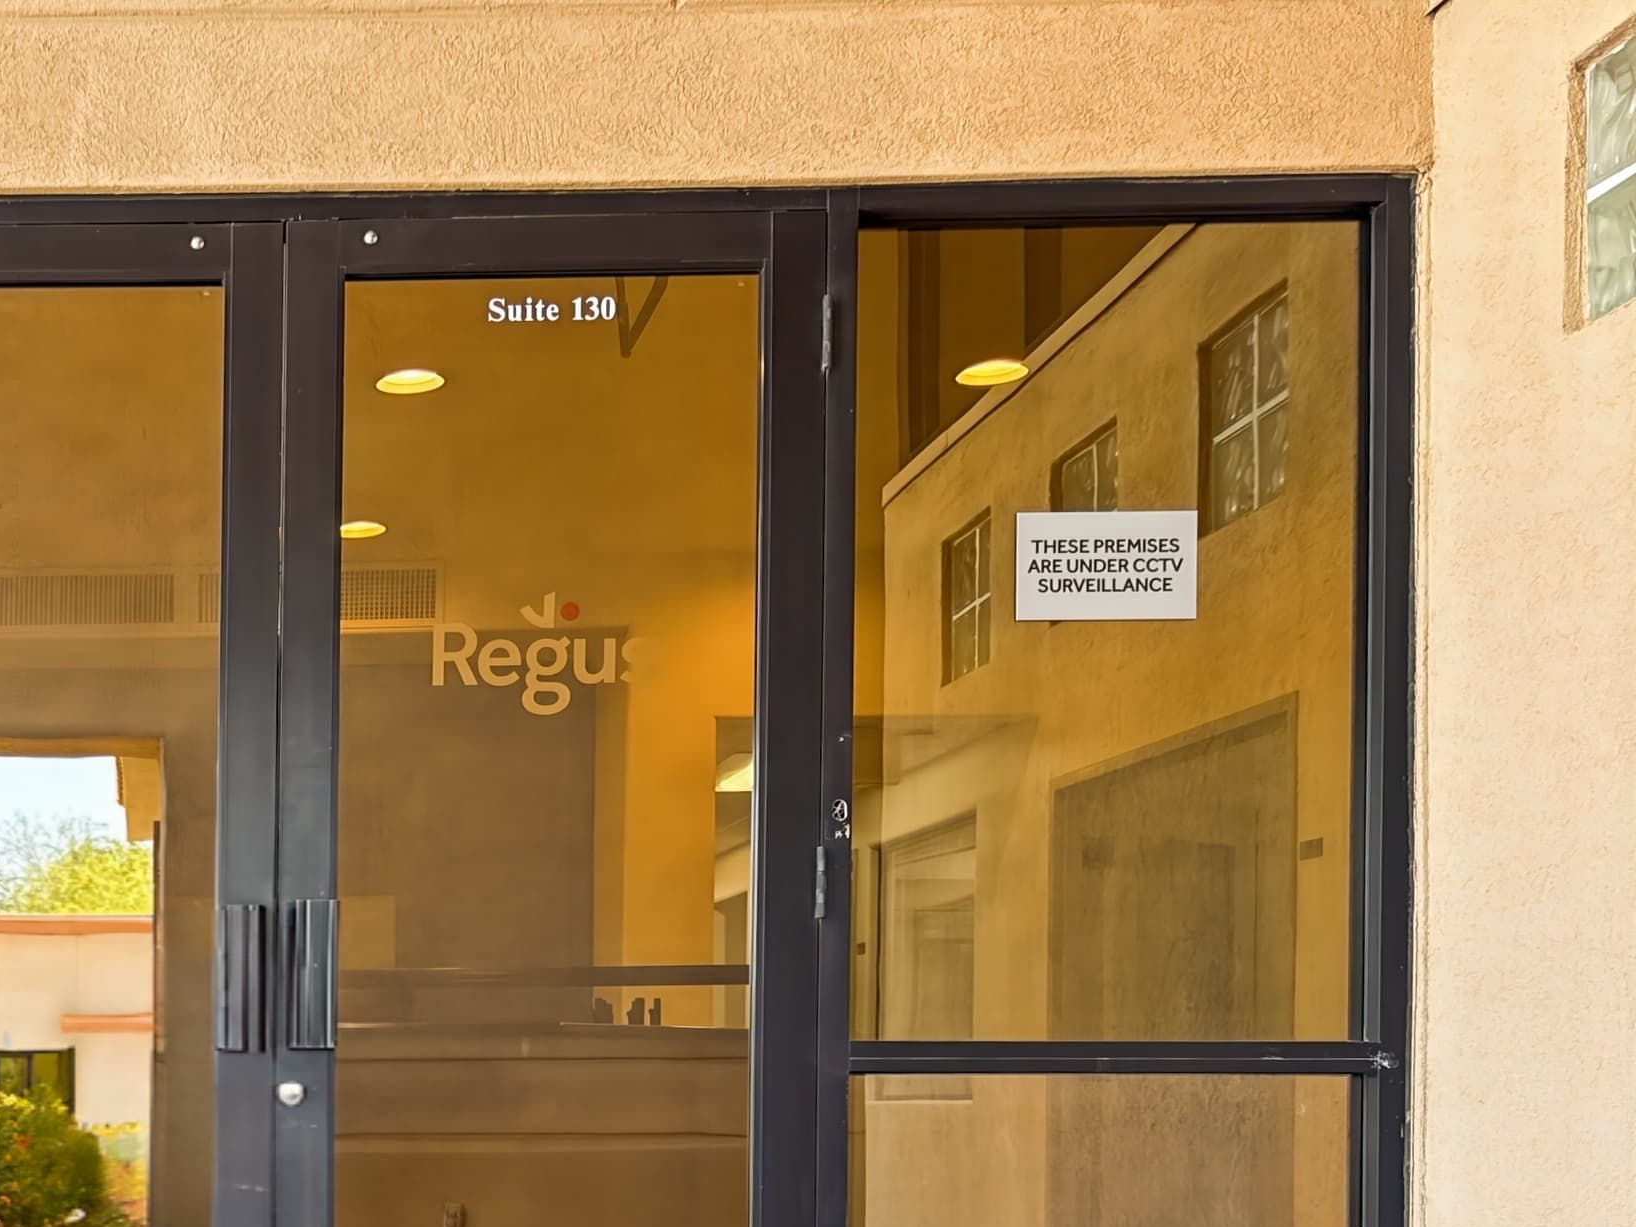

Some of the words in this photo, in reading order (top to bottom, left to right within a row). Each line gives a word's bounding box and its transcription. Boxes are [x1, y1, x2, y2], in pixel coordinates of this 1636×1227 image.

[488, 296, 560, 322] Suite
[571, 296, 617, 321] 130
[1031, 539, 1090, 554] THESE
[1093, 538, 1180, 554] PREMISES
[1027, 558, 1063, 574] ARE
[1066, 558, 1130, 574] UNDER
[1133, 557, 1184, 573] CCTV
[1038, 577, 1173, 593] SURVEILLANCE
